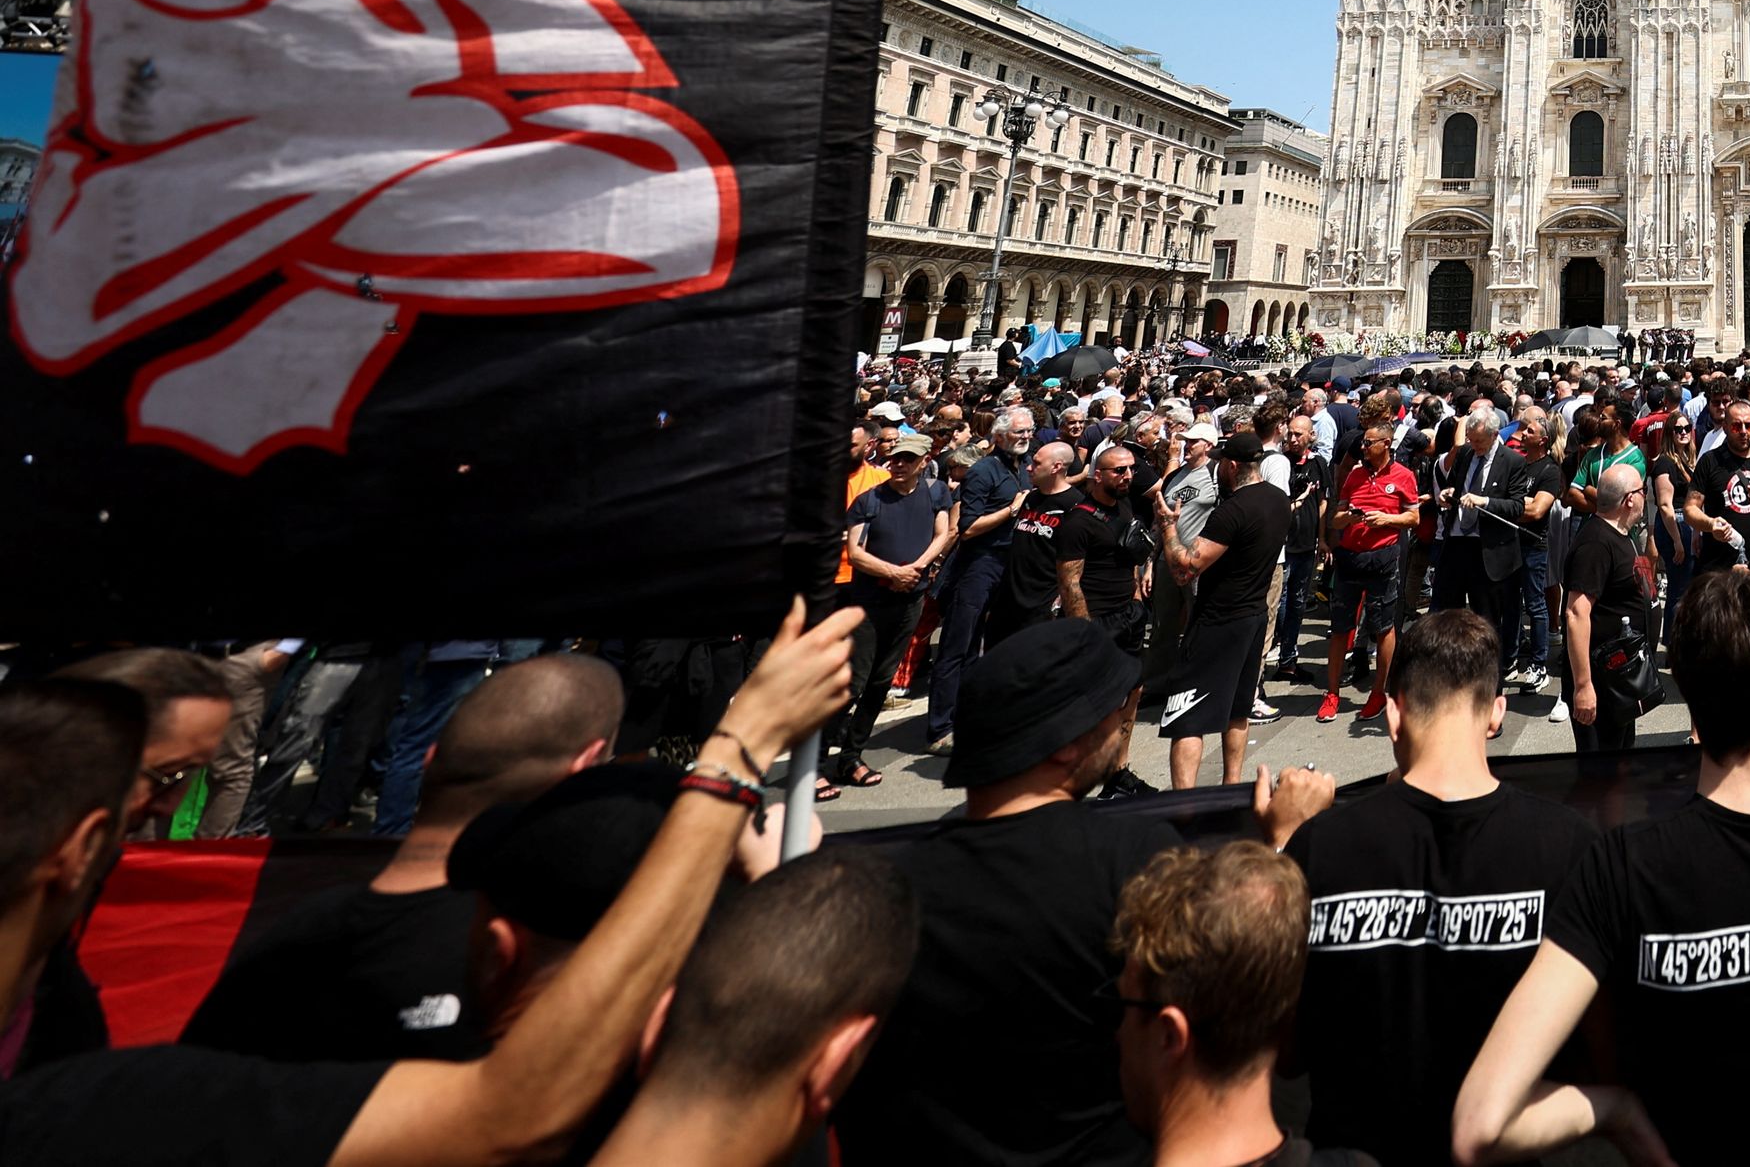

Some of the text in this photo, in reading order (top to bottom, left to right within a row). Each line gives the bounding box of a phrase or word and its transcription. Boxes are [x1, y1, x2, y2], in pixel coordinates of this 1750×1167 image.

[885, 312, 901, 324] M
[1040, 514, 1060, 528] SUD
[1164, 688, 1197, 713] NIKE
